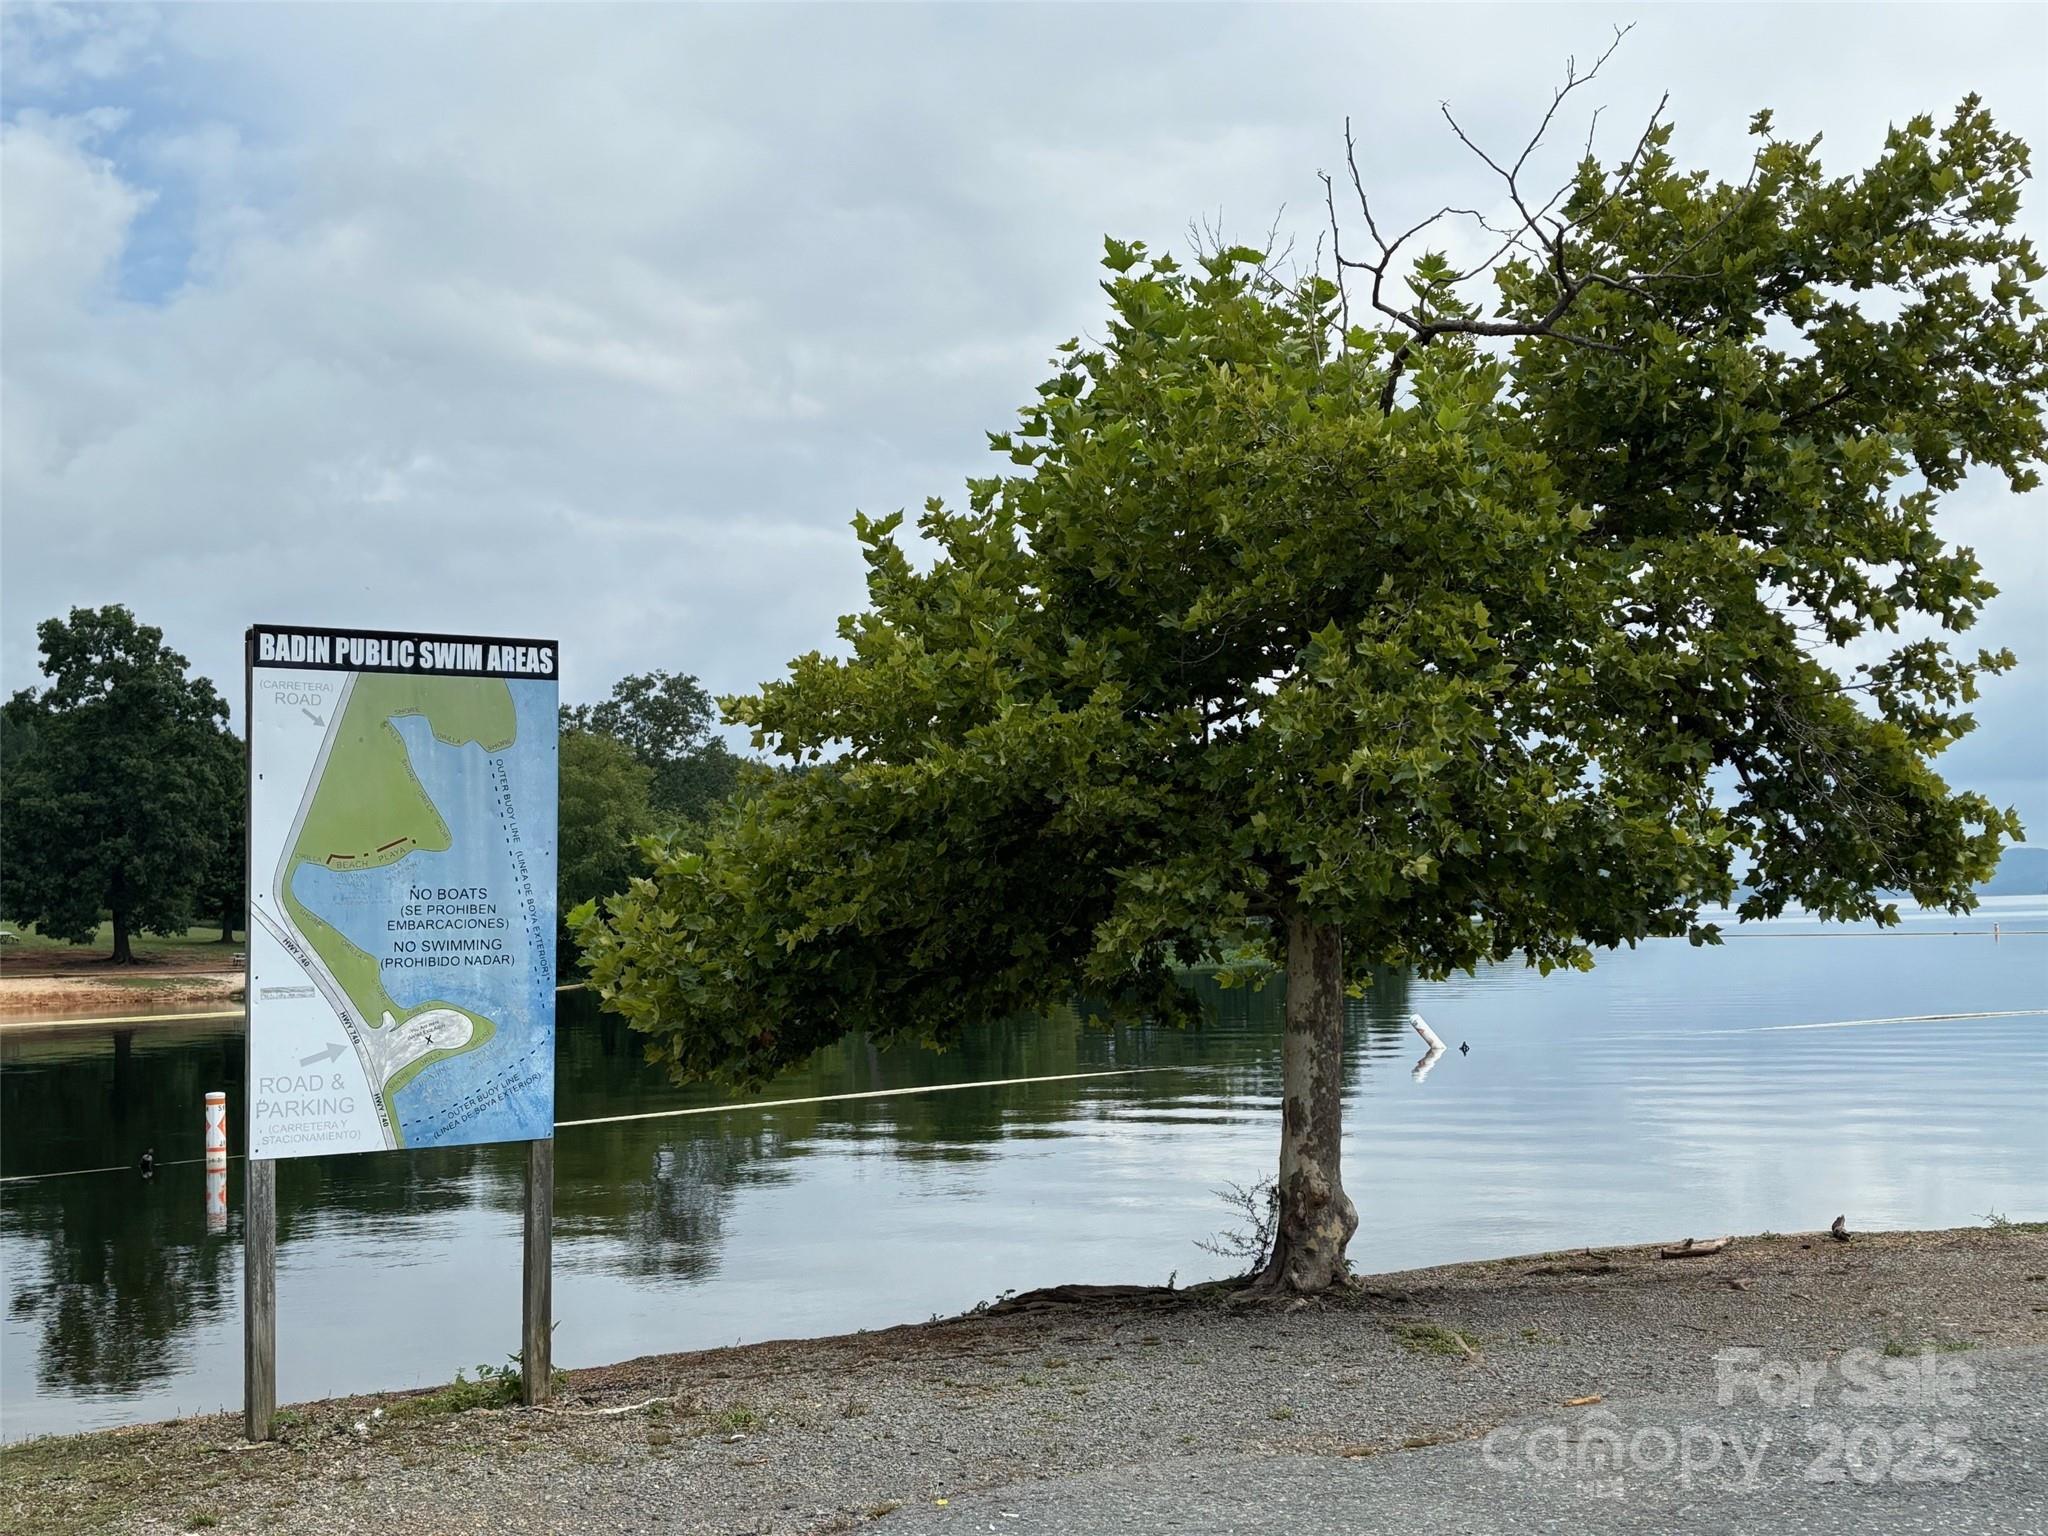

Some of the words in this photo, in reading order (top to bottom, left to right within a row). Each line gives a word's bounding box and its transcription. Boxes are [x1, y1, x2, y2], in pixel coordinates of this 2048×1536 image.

[260, 633, 330, 664] BADIN
[335, 637, 414, 668] PUBLIC
[420, 641, 483, 671] SWIM
[487, 645, 553, 674] AREAS
[260, 680, 334, 692] (CARRETERA)
[275, 692, 322, 705] ROAD
[496, 759, 509, 792] OUTER
[504, 794, 516, 820] BUOY
[510, 823, 521, 843] LINE
[336, 860, 369, 869] BEACH
[378, 847, 406, 862] PLAYA
[515, 851, 529, 881] (LINEA
[410, 888, 432, 900] NO
[437, 888, 488, 900] BOATS
[524, 883, 533, 896] DE
[400, 905, 422, 918] (SE
[427, 904, 496, 915] PROHIBEN
[527, 898, 538, 924] BOYA
[387, 918, 509, 931] EMBARCACIONES)
[283, 938, 299, 955] HWY
[298, 953, 310, 968] 740
[393, 941, 417, 953] NO
[421, 939, 502, 952] SWIMMING
[380, 956, 460, 970] (PROHIBIDO
[464, 955, 515, 967] NADAR)
[340, 1011, 354, 1028] HWY
[350, 1029, 360, 1045] 740
[259, 1074, 324, 1094] ROAD
[331, 1073, 345, 1090] &
[433, 1120, 460, 1140] (LINEA
[461, 1111, 474, 1122] DE
[476, 1099, 497, 1116] BOYA
[498, 1071, 542, 1101] EXTERIOR)
[448, 1098, 477, 1119] OUTER
[478, 1084, 499, 1102] BUOY
[502, 1073, 520, 1089] LINE
[256, 1096, 354, 1119] PARKING
[374, 1092, 385, 1112] HWY
[380, 1113, 390, 1128] 740
[269, 1121, 339, 1134] (CARRETERA
[341, 1119, 348, 1128] Y
[262, 1129, 360, 1145] STACIONAMIENTO)
